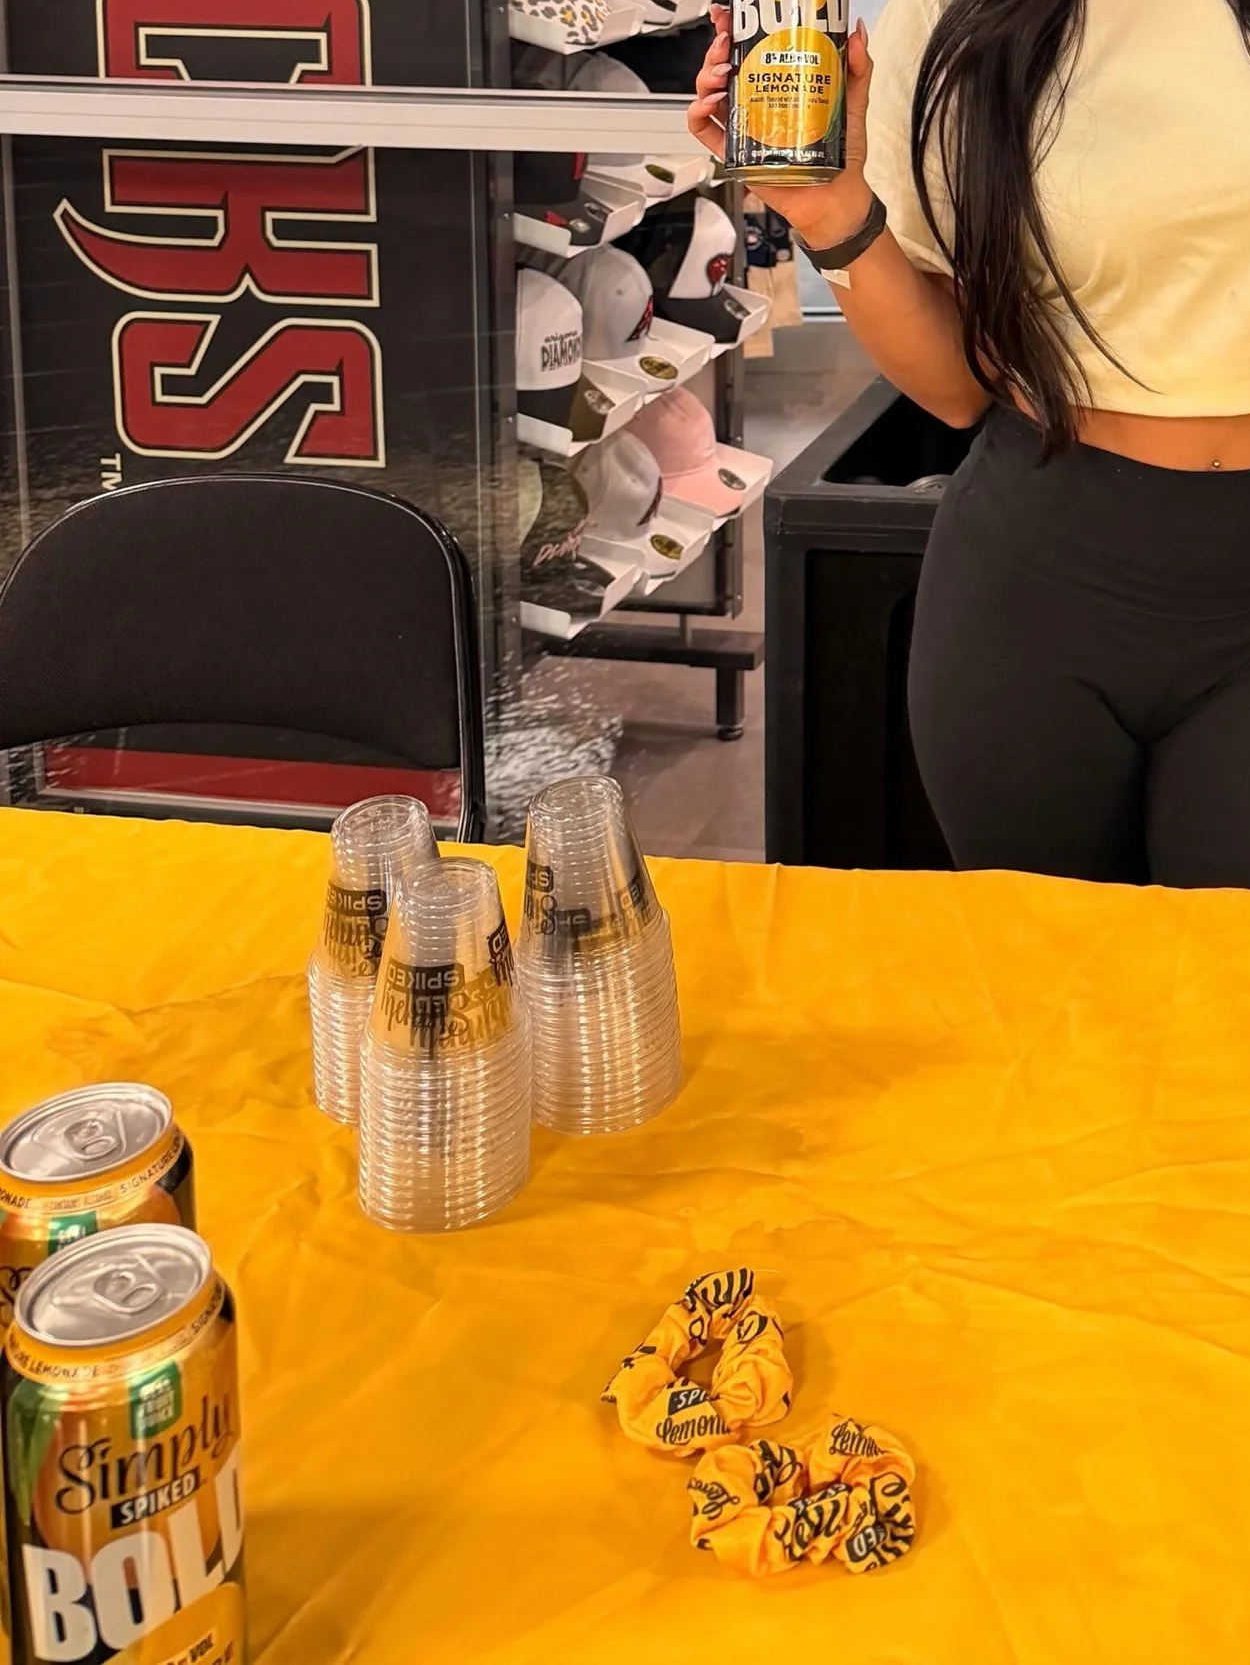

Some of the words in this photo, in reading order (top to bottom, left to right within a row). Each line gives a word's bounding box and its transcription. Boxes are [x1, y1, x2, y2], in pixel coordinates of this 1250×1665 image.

[748, 72, 832, 85] SIGNATURE
[387, 962, 460, 992] SPIKED
[119, 1148, 176, 1195] SIGNATURE
[55, 1393, 236, 1516] Simply
[117, 1472, 197, 1527] SPIKED
[23, 1442, 244, 1664] BOLD
